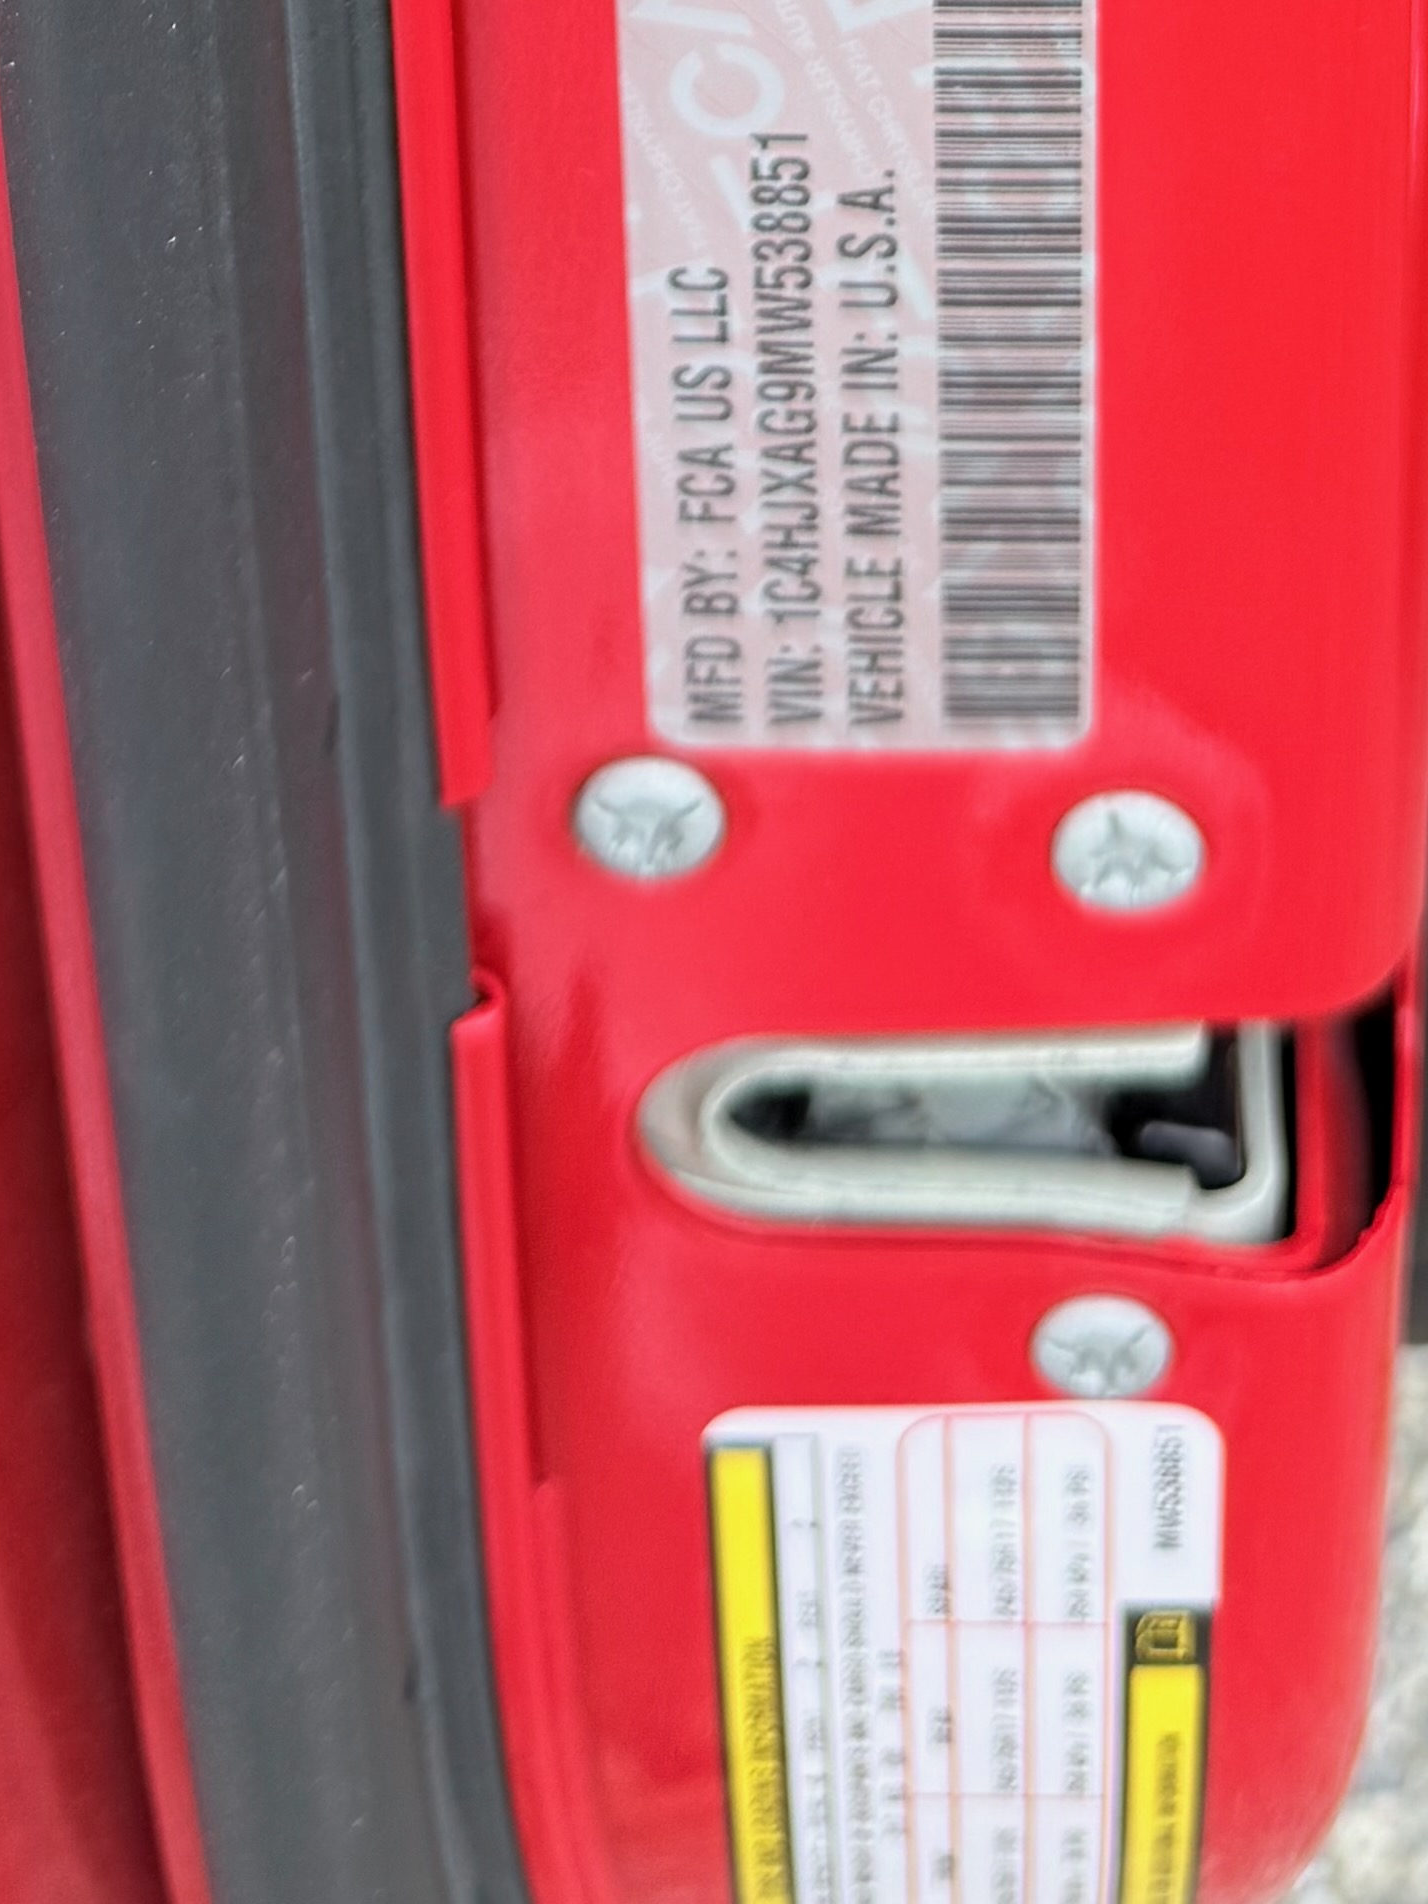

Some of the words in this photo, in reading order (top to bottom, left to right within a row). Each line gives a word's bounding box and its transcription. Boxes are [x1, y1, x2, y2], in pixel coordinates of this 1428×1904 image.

[836, 170, 899, 308] U.S.A.
[668, 268, 730, 346] LLC
[672, 366, 734, 422] US
[751, 134, 822, 626] 1C4HJXAG9MW538851
[842, 334, 899, 391] IN:
[677, 445, 736, 524] FCA
[843, 414, 901, 538] MADE
[683, 551, 739, 618] BY:
[685, 637, 742, 725] MFD
[846, 560, 905, 726] VEHICLE
[768, 647, 823, 727] VIN:
